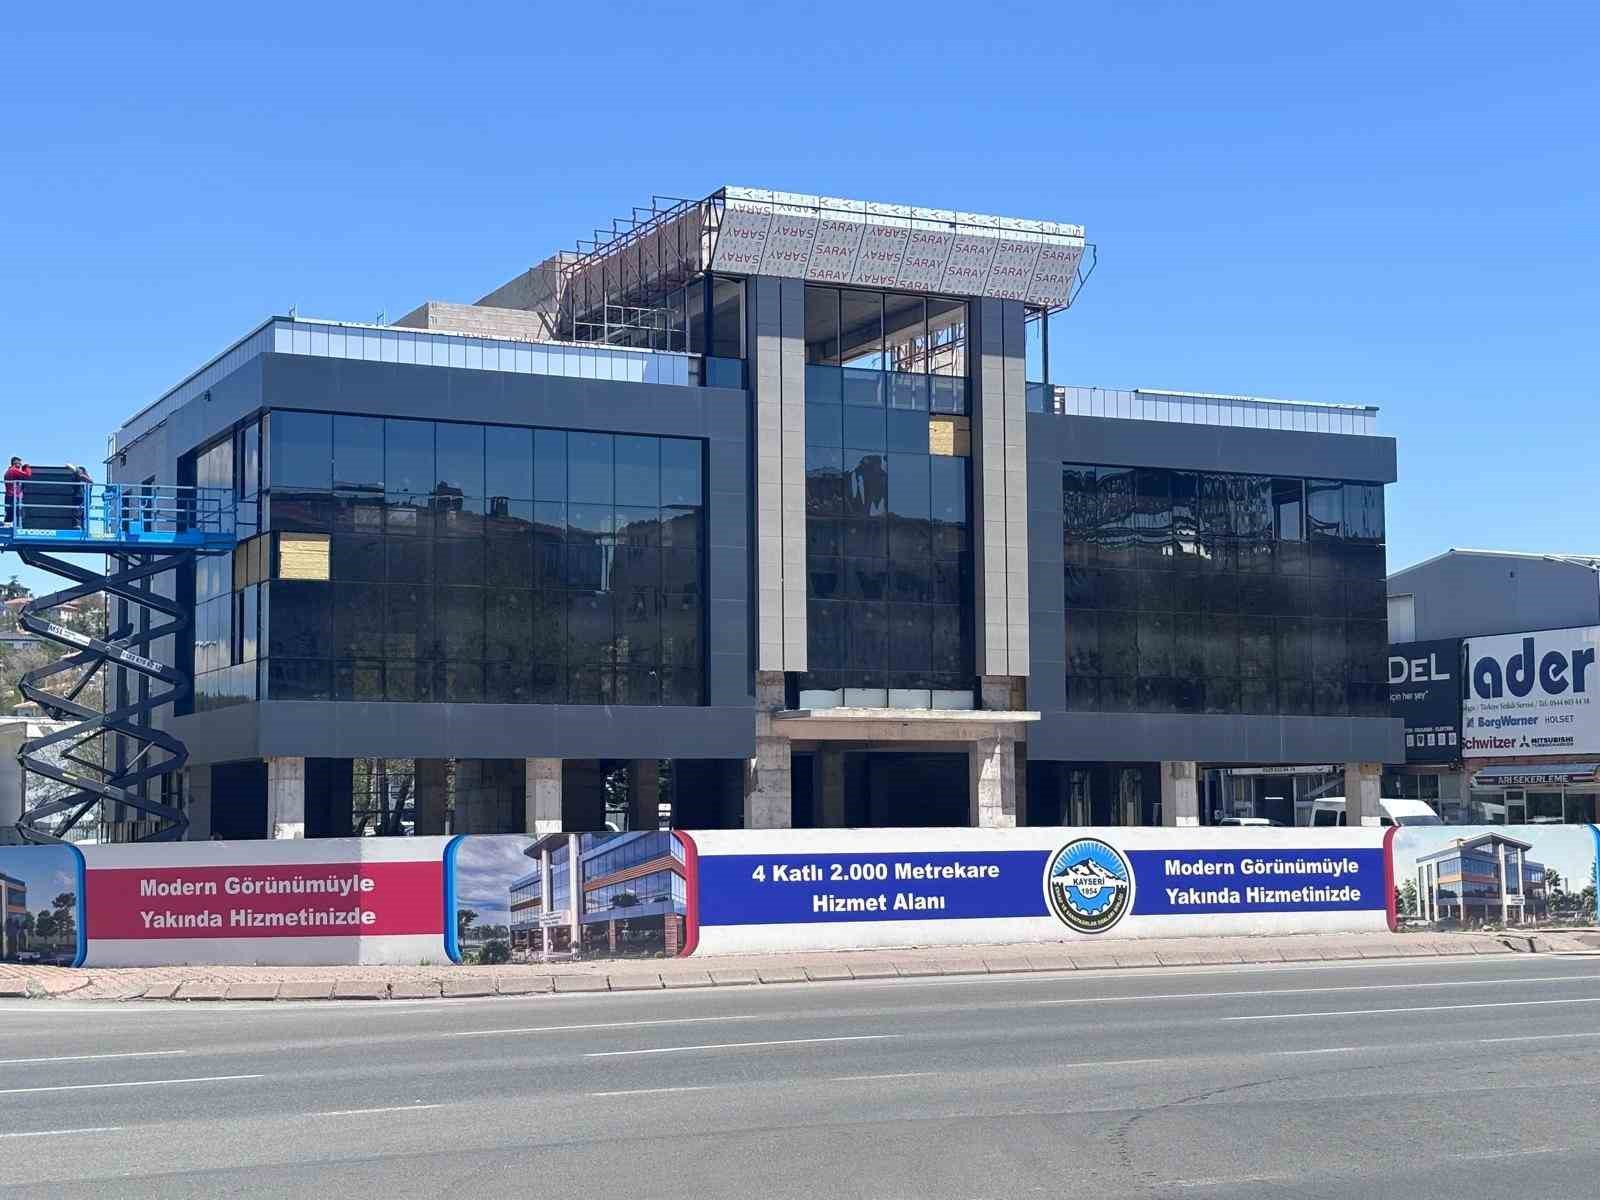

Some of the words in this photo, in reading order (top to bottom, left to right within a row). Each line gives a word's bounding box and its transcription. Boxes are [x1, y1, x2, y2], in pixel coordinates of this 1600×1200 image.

[774, 226, 814, 239] SARAY
[821, 221, 861, 233] SARAY
[871, 226, 908, 240] SARAY
[725, 227, 767, 241] SARAY
[911, 233, 951, 246] SARAY
[815, 245, 855, 257] SARAY
[955, 243, 993, 257] SARAY
[1000, 243, 1038, 255] SARAY
[720, 251, 760, 265] SARAY
[769, 251, 809, 264] SARAY
[863, 250, 902, 263] SARAY
[1042, 250, 1079, 263] SARAY
[906, 257, 944, 270] SARAY
[809, 268, 850, 281] SARAY
[948, 266, 986, 279] SARAY
[993, 266, 1031, 279] SARAY
[857, 273, 896, 286] SARAY
[1035, 273, 1072, 286] SARAY
[987, 289, 1025, 301] SARAY
[1477, 715, 1538, 729] BorgWarner
[1545, 715, 1574, 724] HOLSET
[752, 865, 765, 882] 4
[773, 864, 823, 882] Katlı
[830, 863, 887, 881] 2.000
[895, 861, 1000, 880] Metrekare
[1165, 859, 1235, 876] Modern
[1240, 858, 1359, 877] Görünümüyle
[140, 878, 217, 896] Modern
[224, 875, 375, 896] Görünümüyle
[1073, 877, 1105, 886] KAYSERİ
[813, 893, 887, 912] Hizmet
[893, 892, 945, 910] Alanı
[1166, 887, 1240, 905] Yakında
[1246, 886, 1361, 903] Hizmetinizde
[140, 908, 222, 929] Yakında
[230, 907, 376, 927] Hizmetinizde
